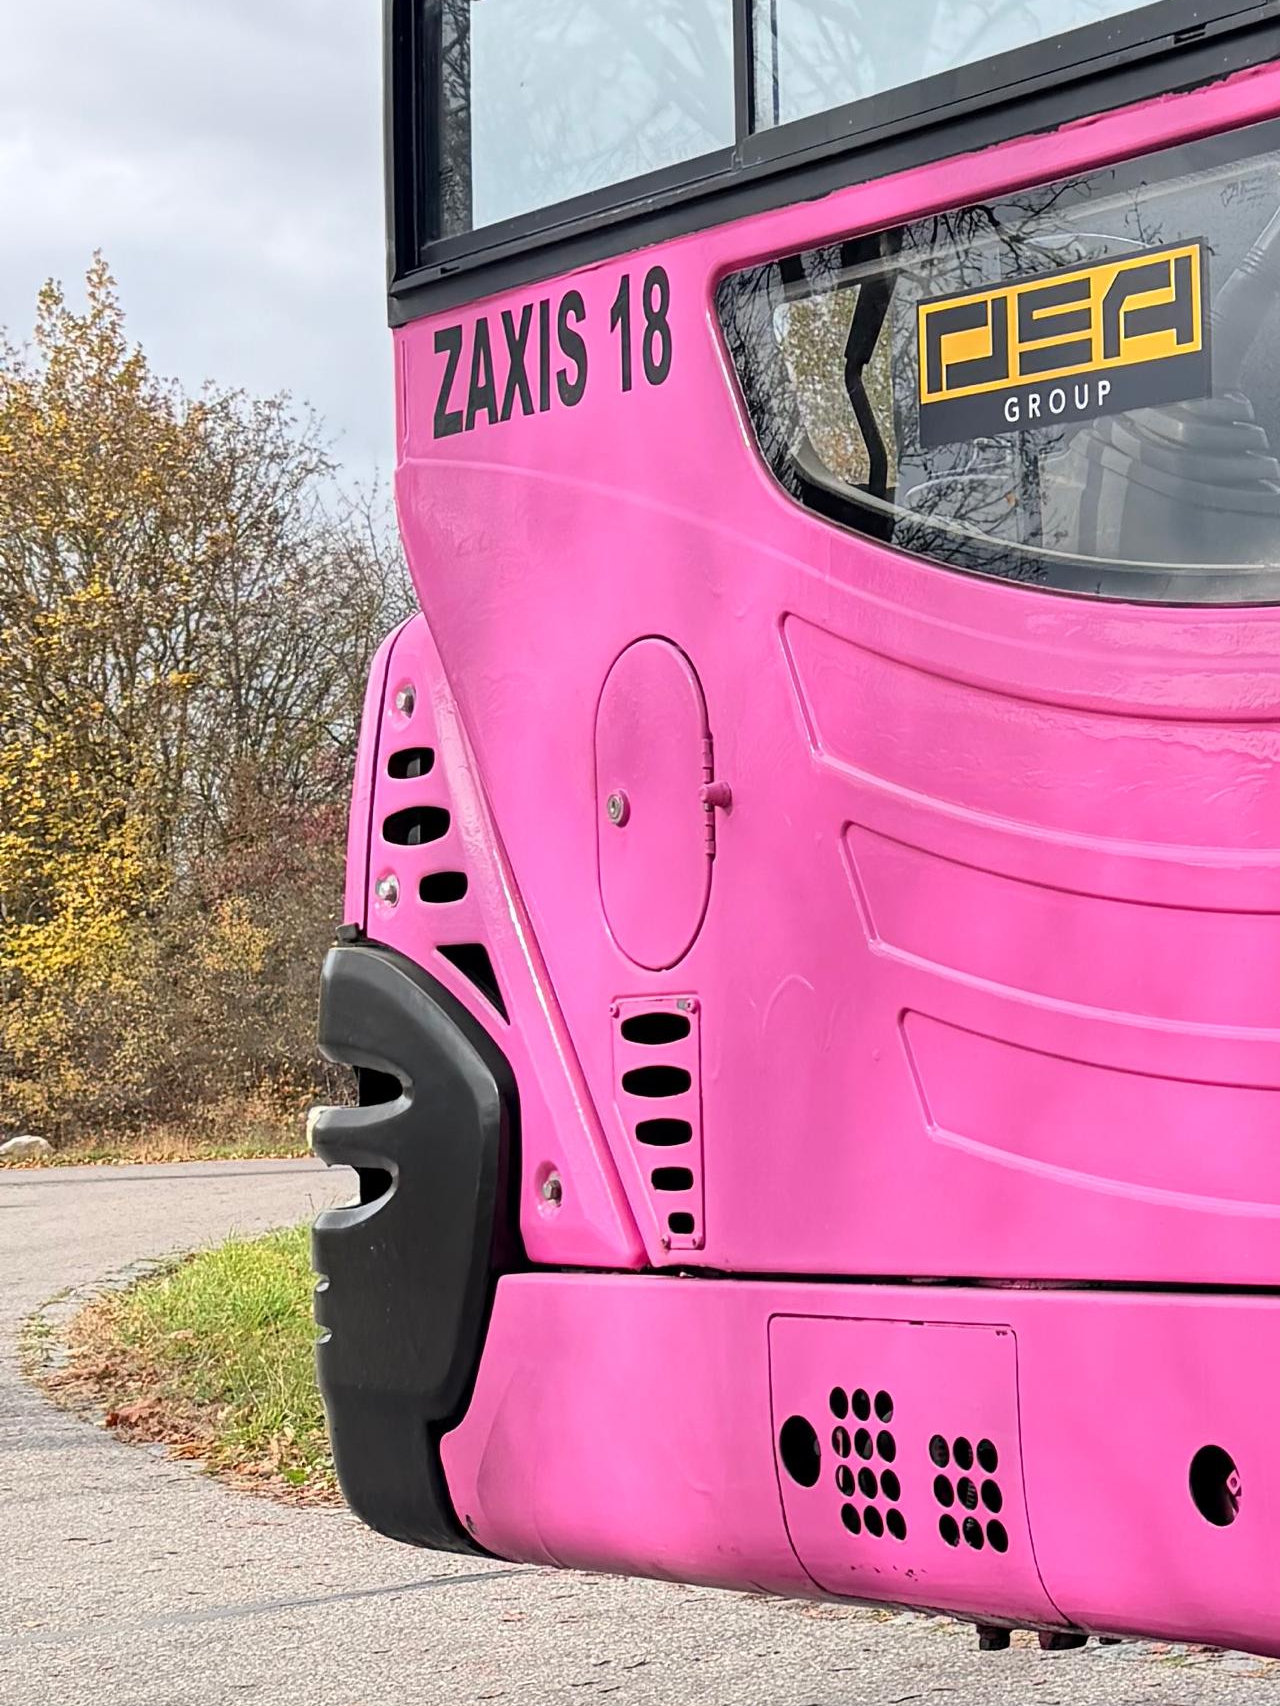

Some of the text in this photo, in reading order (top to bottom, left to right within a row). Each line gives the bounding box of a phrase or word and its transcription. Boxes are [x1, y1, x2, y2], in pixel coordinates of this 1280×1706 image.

[433, 265, 673, 440] ZAXIS 18
[1004, 379, 1112, 423] GROUP
